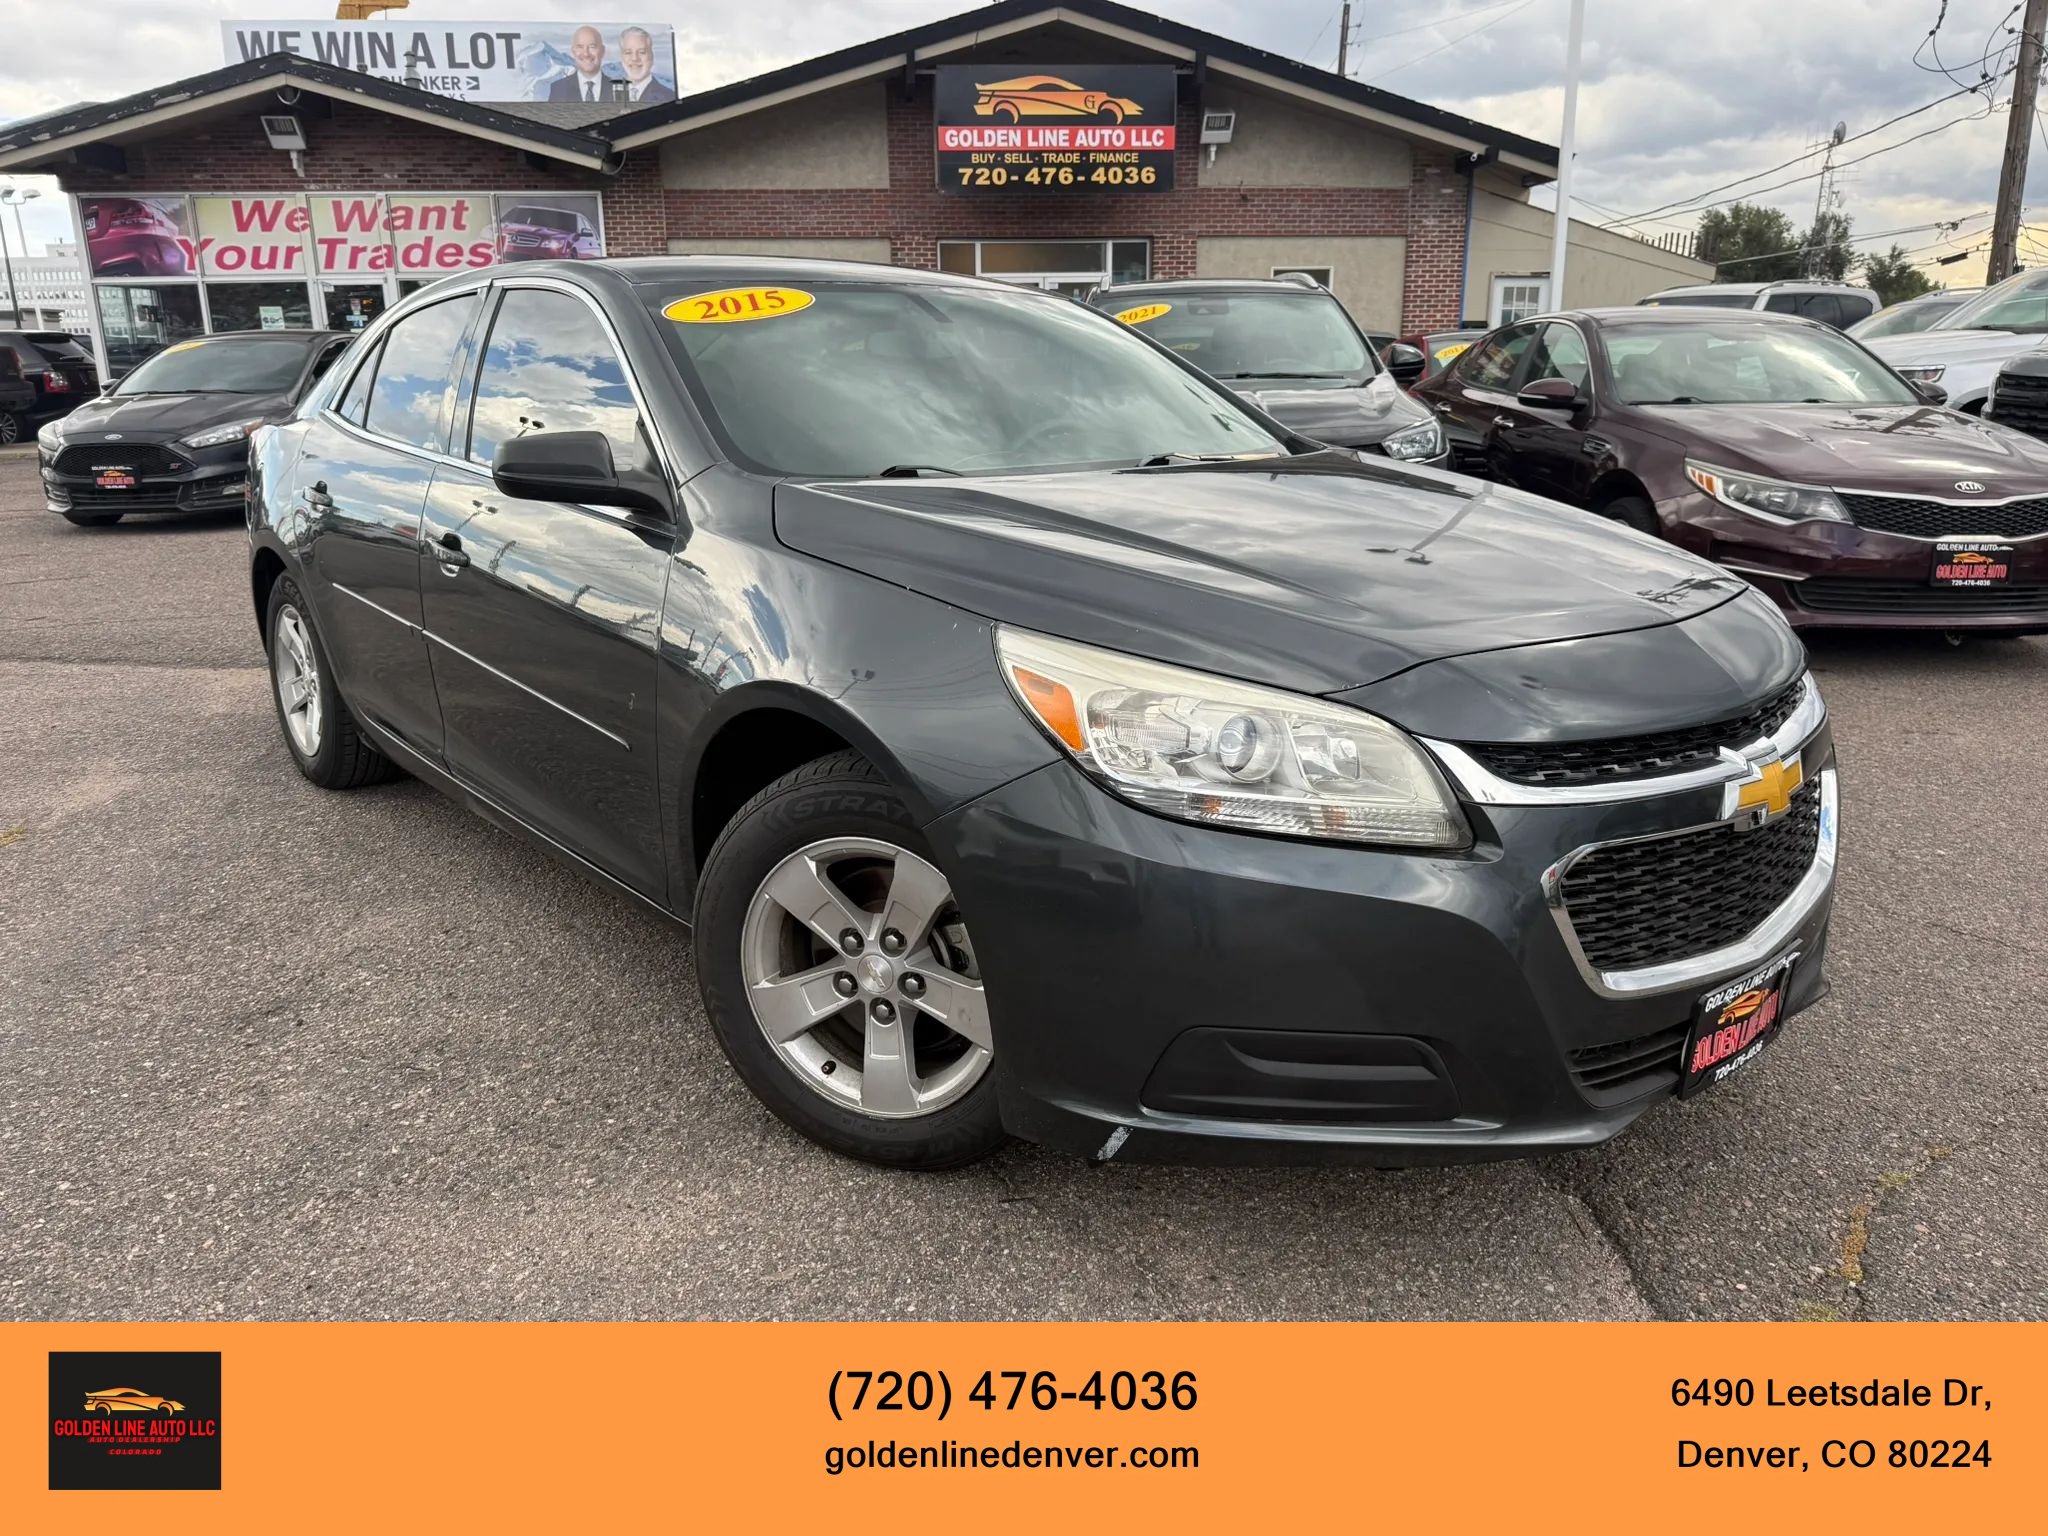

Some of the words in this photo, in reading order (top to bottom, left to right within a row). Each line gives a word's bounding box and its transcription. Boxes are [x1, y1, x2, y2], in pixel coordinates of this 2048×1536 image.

[312, 31, 397, 69] WIN
[408, 32, 436, 69] A
[445, 32, 521, 69] LOT
[944, 129, 1022, 148] GOLDEN
[1027, 129, 1070, 148] LINE
[1075, 129, 1126, 147] AUTO
[1131, 129, 1165, 147] LLC
[971, 153, 996, 164] BUY
[1004, 153, 1034, 164] SELL
[1042, 153, 1080, 164] TRADE
[1089, 153, 1139, 163] FINANCE
[231, 199, 311, 234] We
[331, 198, 470, 233] Want
[176, 237, 303, 271] Your
[694, 290, 786, 320] 2015
[1120, 306, 1157, 323] 2021
[1960, 481, 1981, 491] KIA
[1936, 543, 1963, 551] GOLDEN
[1963, 543, 1979, 551] LINE
[1935, 564, 1968, 579] GOLDEN
[1968, 564, 1987, 579] LINE
[1986, 564, 2007, 579] AUTO
[1704, 981, 1746, 1013] GOLDEN
[1744, 970, 1767, 991] LINE
